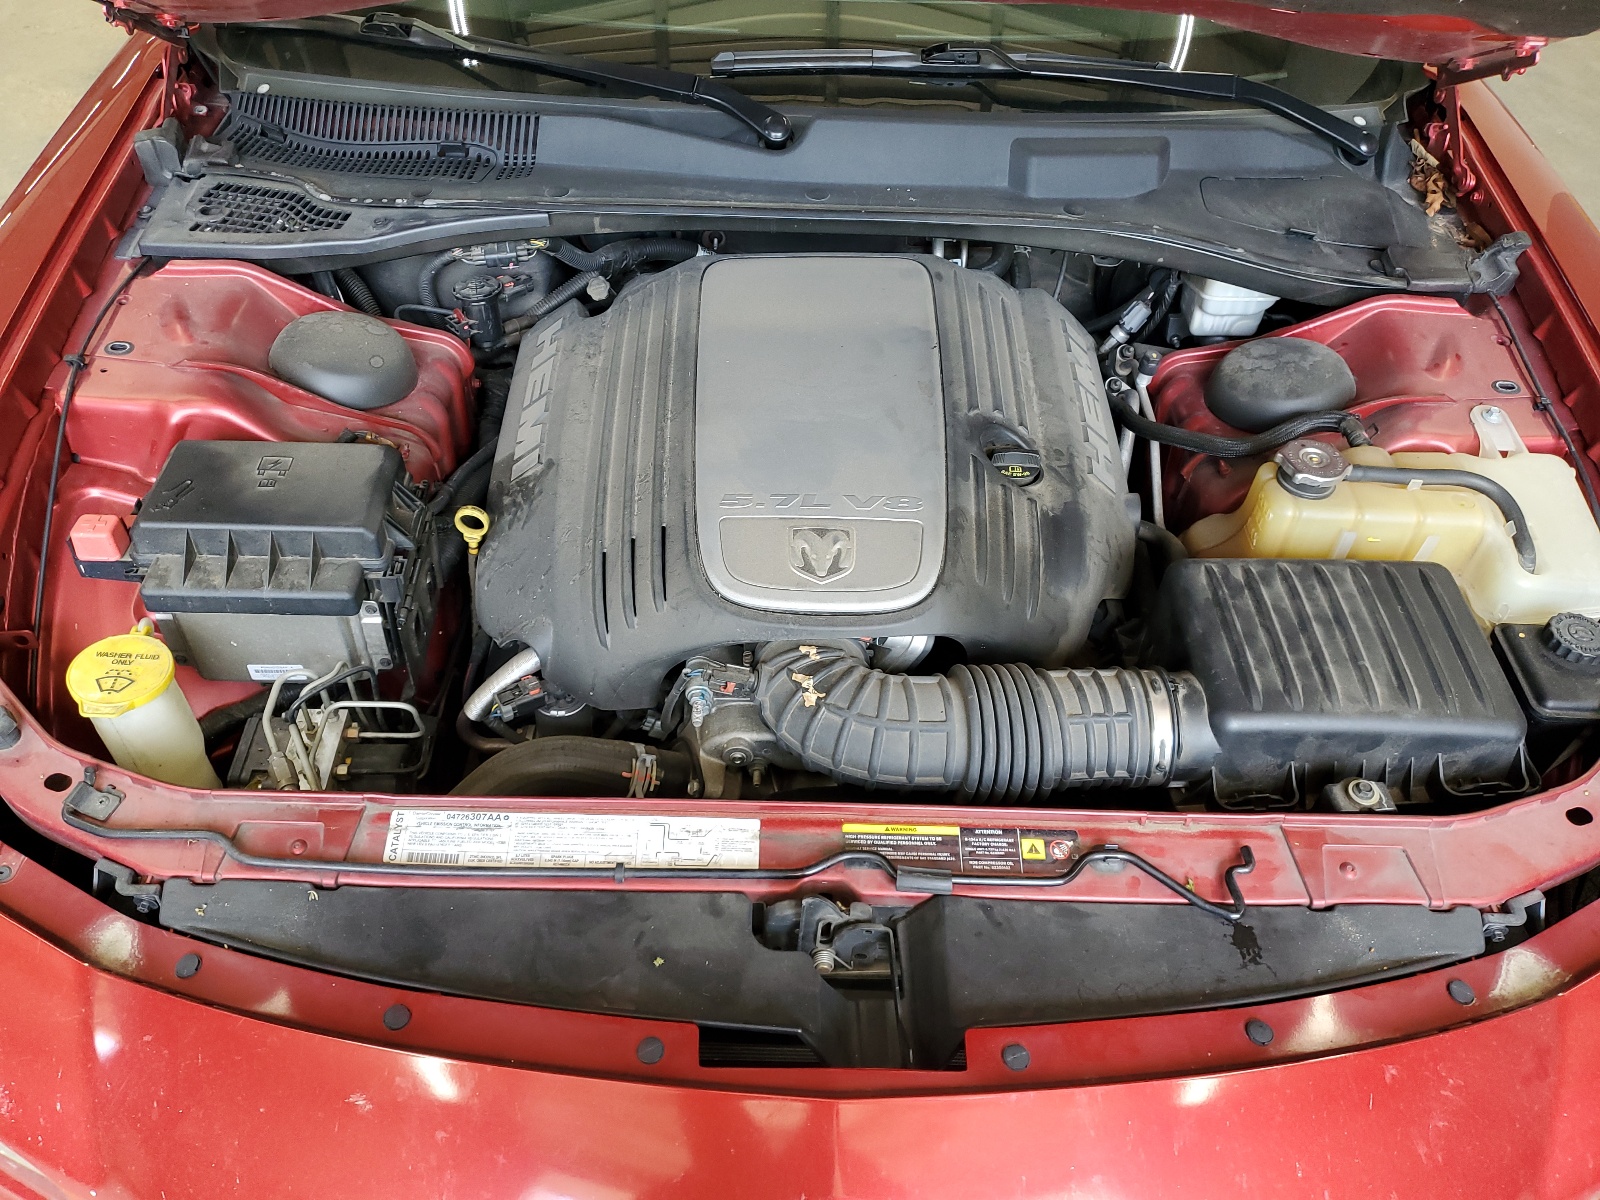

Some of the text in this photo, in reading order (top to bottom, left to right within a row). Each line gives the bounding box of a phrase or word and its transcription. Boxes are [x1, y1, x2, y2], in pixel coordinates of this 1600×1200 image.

[510, 317, 563, 482] HEMI
[1060, 318, 1116, 496] HEMI
[719, 493, 924, 512] 5.7L V8
[96, 651, 133, 659] WASHER
[446, 812, 502, 822] 04726307AA
[388, 811, 405, 861] CATALYST
